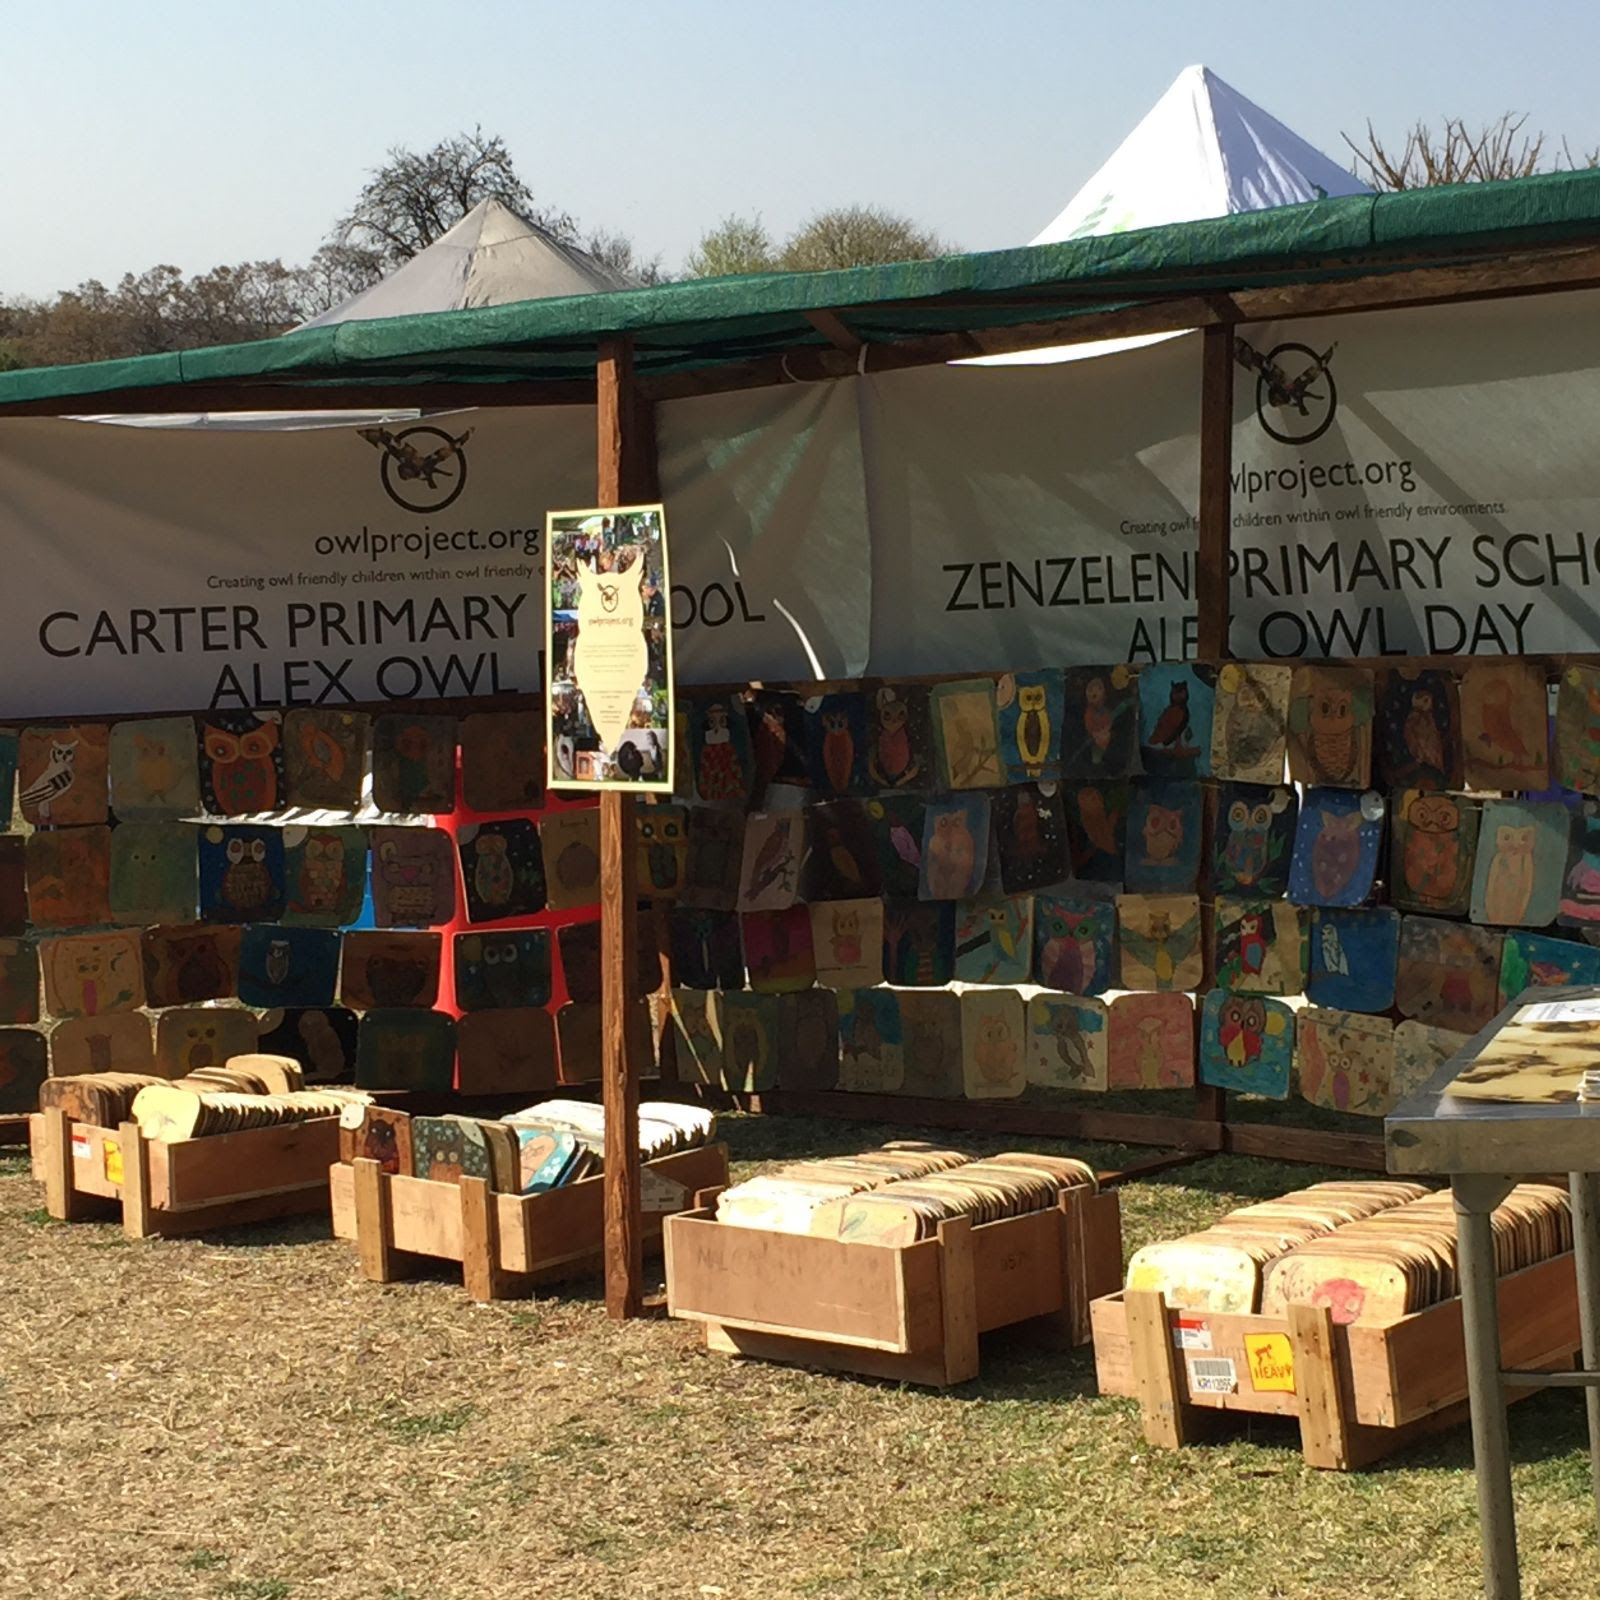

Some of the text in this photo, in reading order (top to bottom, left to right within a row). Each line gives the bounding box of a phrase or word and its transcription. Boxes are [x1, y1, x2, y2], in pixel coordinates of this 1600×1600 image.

[1228, 459, 1417, 502] wlproject.org
[1119, 519, 1168, 537] Creating
[1169, 519, 1191, 533] owl
[1232, 511, 1282, 528] children
[1286, 508, 1330, 524] within
[1334, 506, 1361, 520] owl
[1364, 503, 1413, 521] friendly
[314, 526, 540, 562] owlproject.org
[1472, 531, 1600, 589] SCH
[206, 575, 265, 591] Creating
[268, 574, 294, 587] owl
[297, 571, 348, 589] friendly
[351, 569, 406, 585] children
[410, 567, 451, 582] within
[455, 565, 480, 580] owl
[483, 563, 534, 581] friendly
[38, 580, 766, 658] CARTER PRIMARY OOL
[1258, 605, 1408, 659] OWL
[1423, 602, 1536, 657] DAY
[208, 656, 357, 711] ALEX
[375, 651, 520, 701] OWL
[1253, 1363, 1293, 1380] HEAVY
